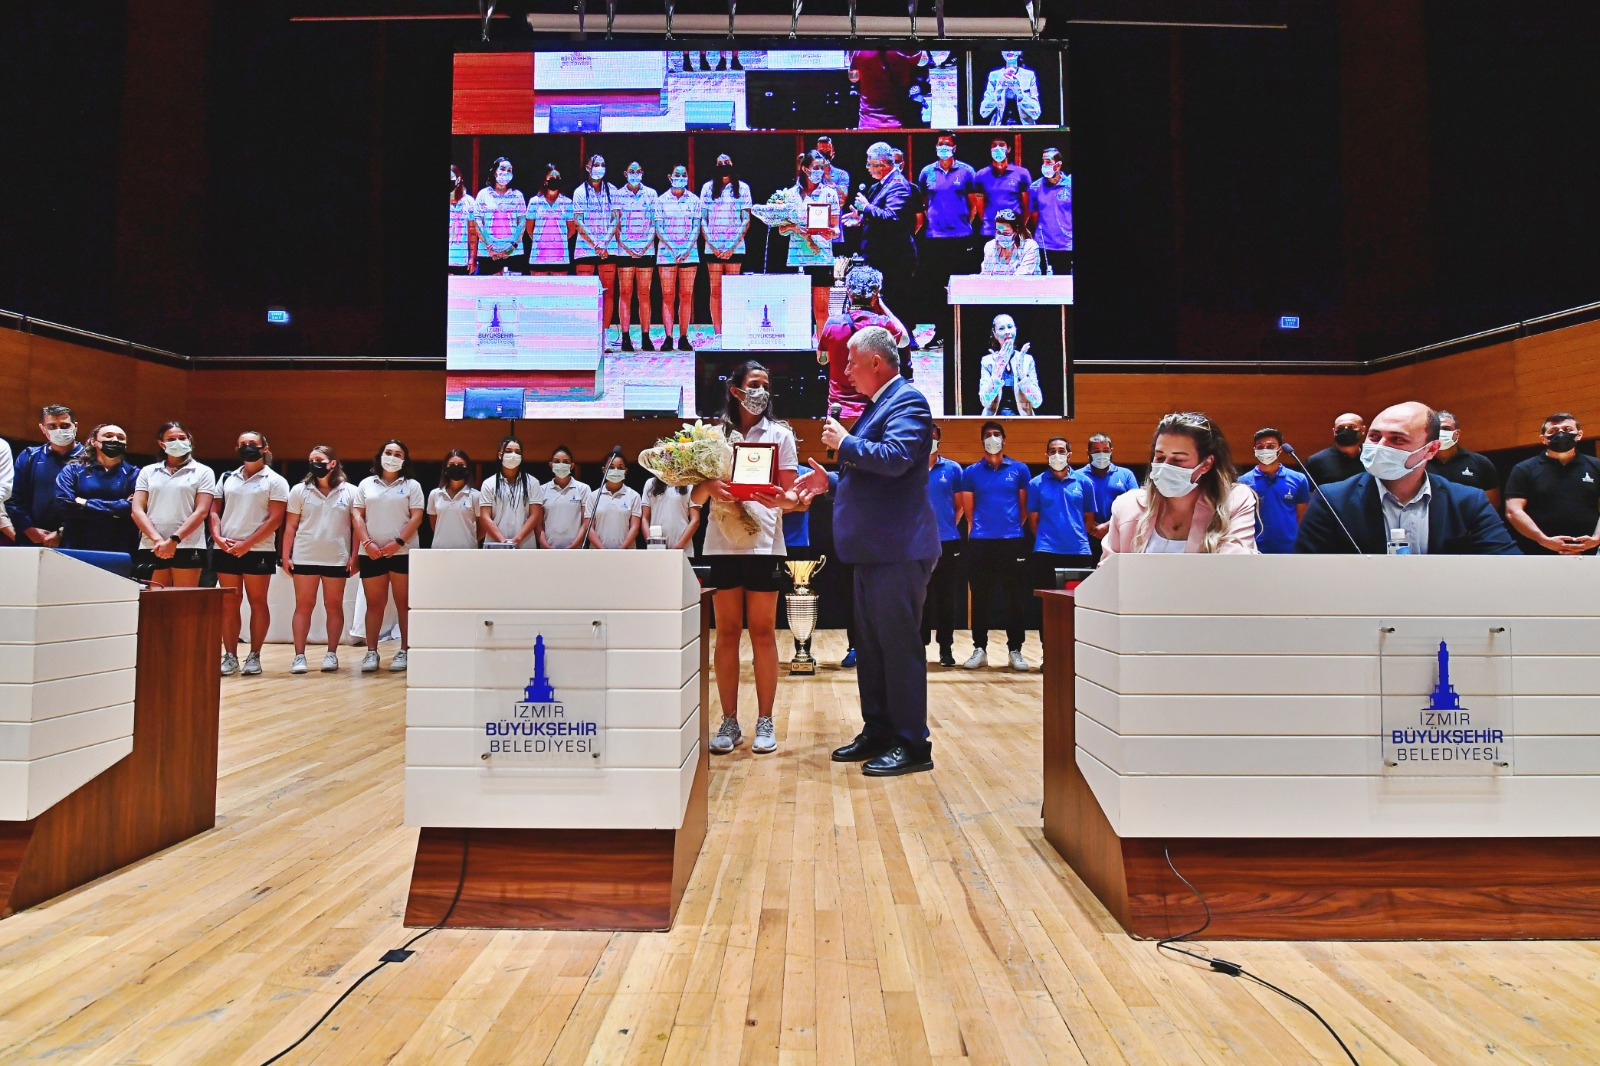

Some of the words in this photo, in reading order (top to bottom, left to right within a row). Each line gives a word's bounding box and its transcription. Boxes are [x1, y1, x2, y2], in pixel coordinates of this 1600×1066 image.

[514, 704, 564, 718] İZMİR
[1420, 711, 1470, 726] İZMİR
[485, 719, 597, 738] BÜYÜKŞEHİR
[1392, 727, 1504, 745] BÜYÜKŞEHİR
[490, 738, 592, 753] BELEDİYESİ
[1397, 746, 1499, 761] BELEDİYESİ
